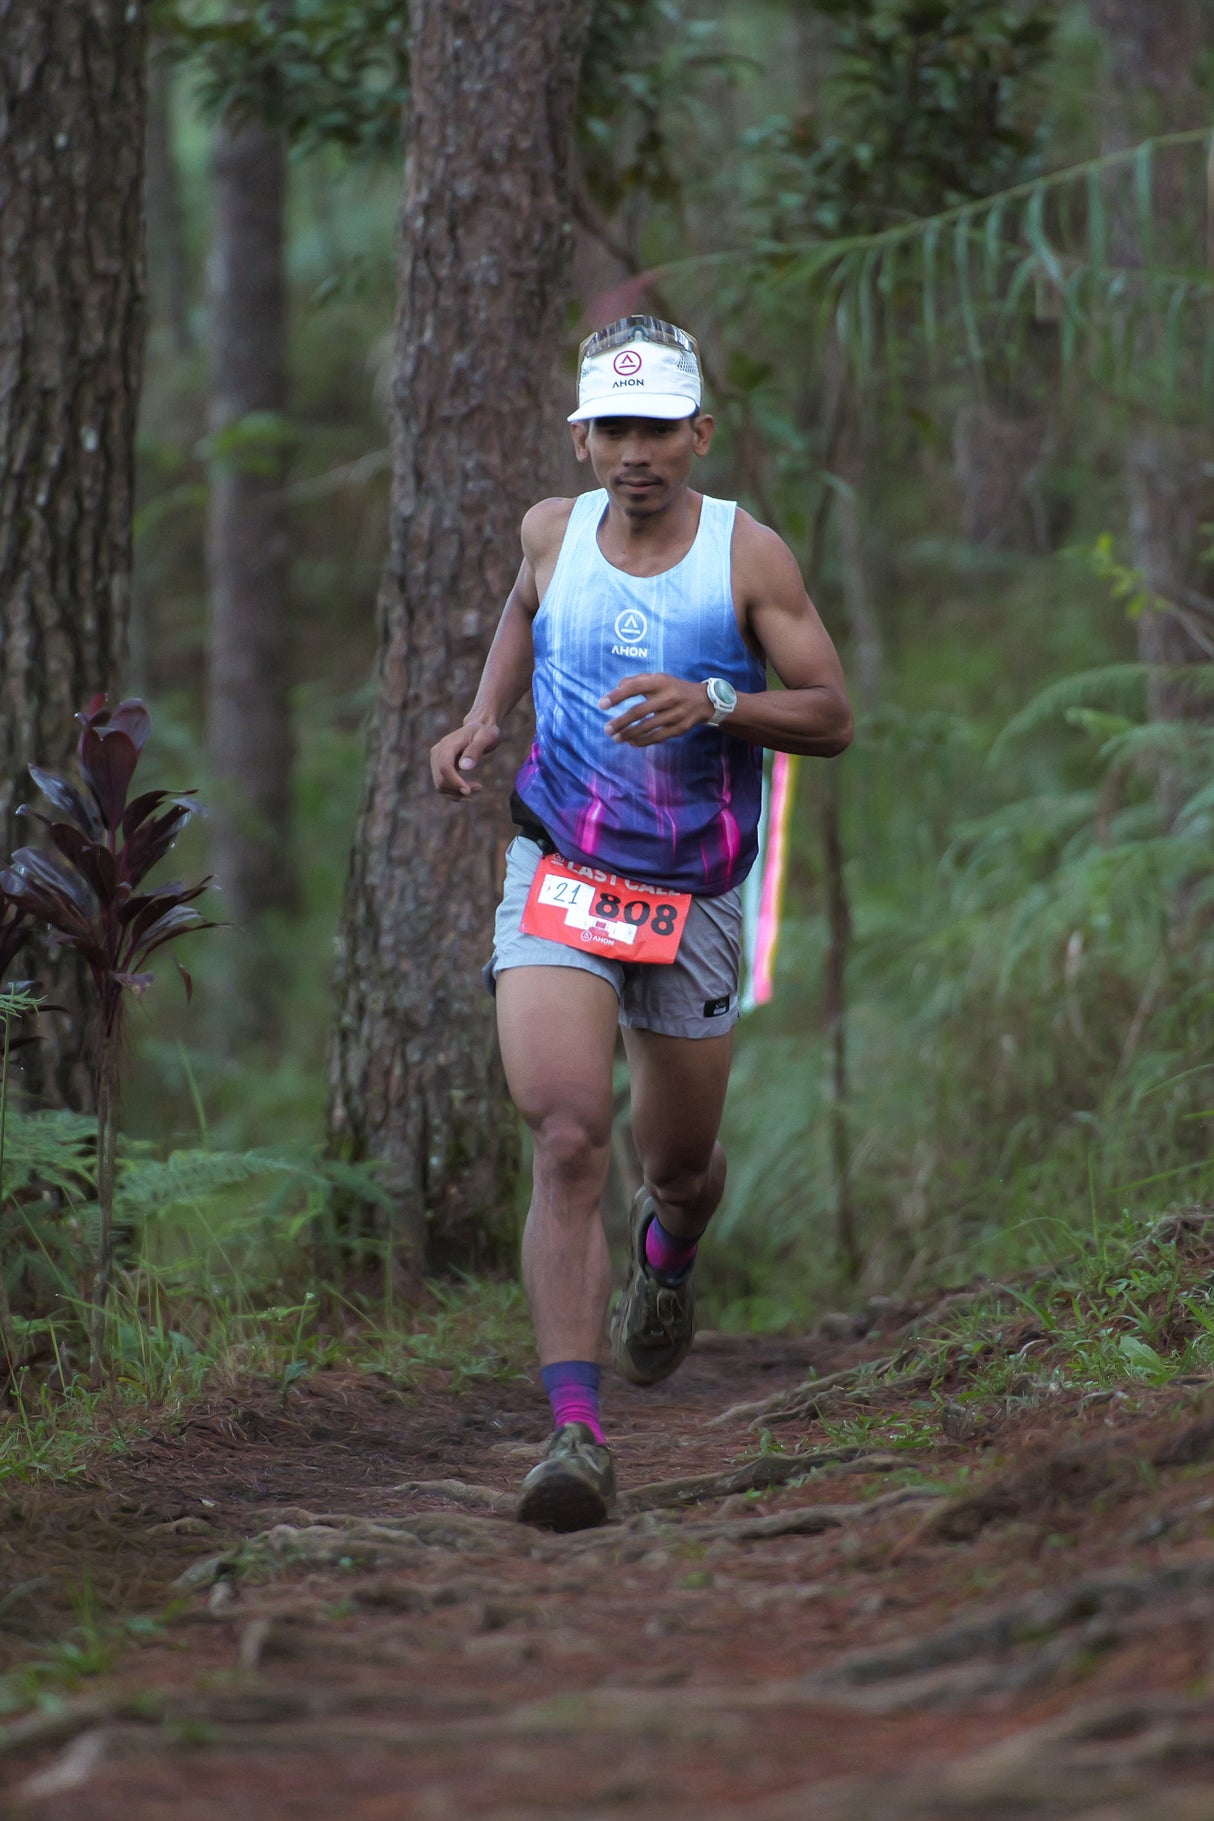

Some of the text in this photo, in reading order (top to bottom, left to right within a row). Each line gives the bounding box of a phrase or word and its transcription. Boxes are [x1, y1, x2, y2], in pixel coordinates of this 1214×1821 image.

[612, 378, 645, 389] AHON
[611, 644, 648, 658] AHON
[553, 882, 581, 905] 21
[595, 892, 678, 937] 808
[592, 935, 615, 946] AHON
